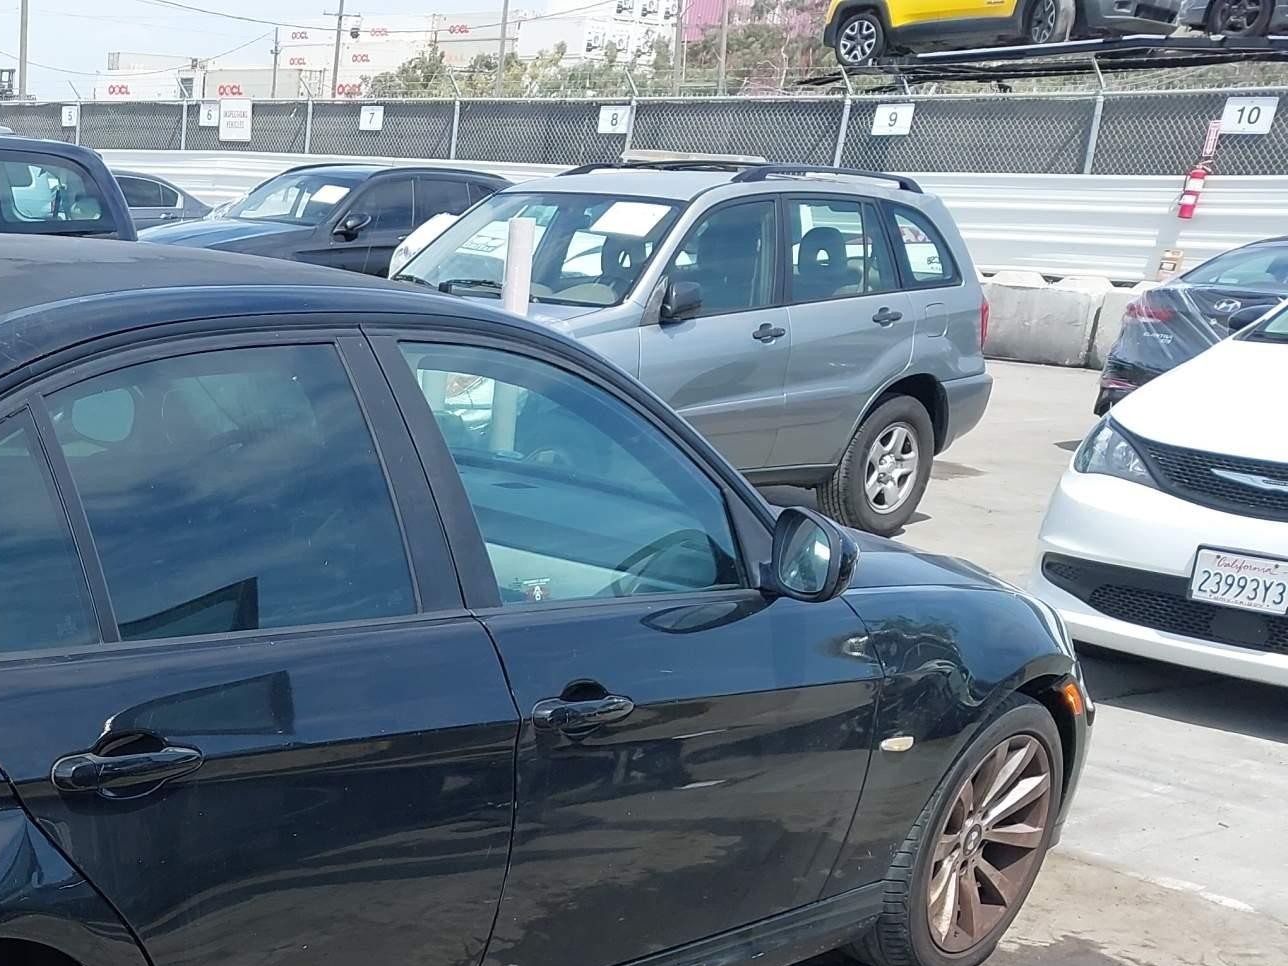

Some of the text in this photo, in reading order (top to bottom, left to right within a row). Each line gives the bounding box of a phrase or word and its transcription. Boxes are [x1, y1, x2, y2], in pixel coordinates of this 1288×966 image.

[449, 24, 469, 34] OOCL
[291, 31, 309, 40] OOCL
[289, 58, 306, 66] OOCL
[352, 54, 370, 63] OOCL
[108, 85, 130, 95] OOCL
[218, 85, 243, 96] OOCL
[67, 111, 73, 121] 5
[206, 109, 214, 121] 6
[610, 112, 618, 127] 8
[888, 111, 898, 127] 9
[1236, 106, 1261, 125] 10
[1216, 557, 1274, 573] California
[1198, 570, 1287, 605] 23993Y3
